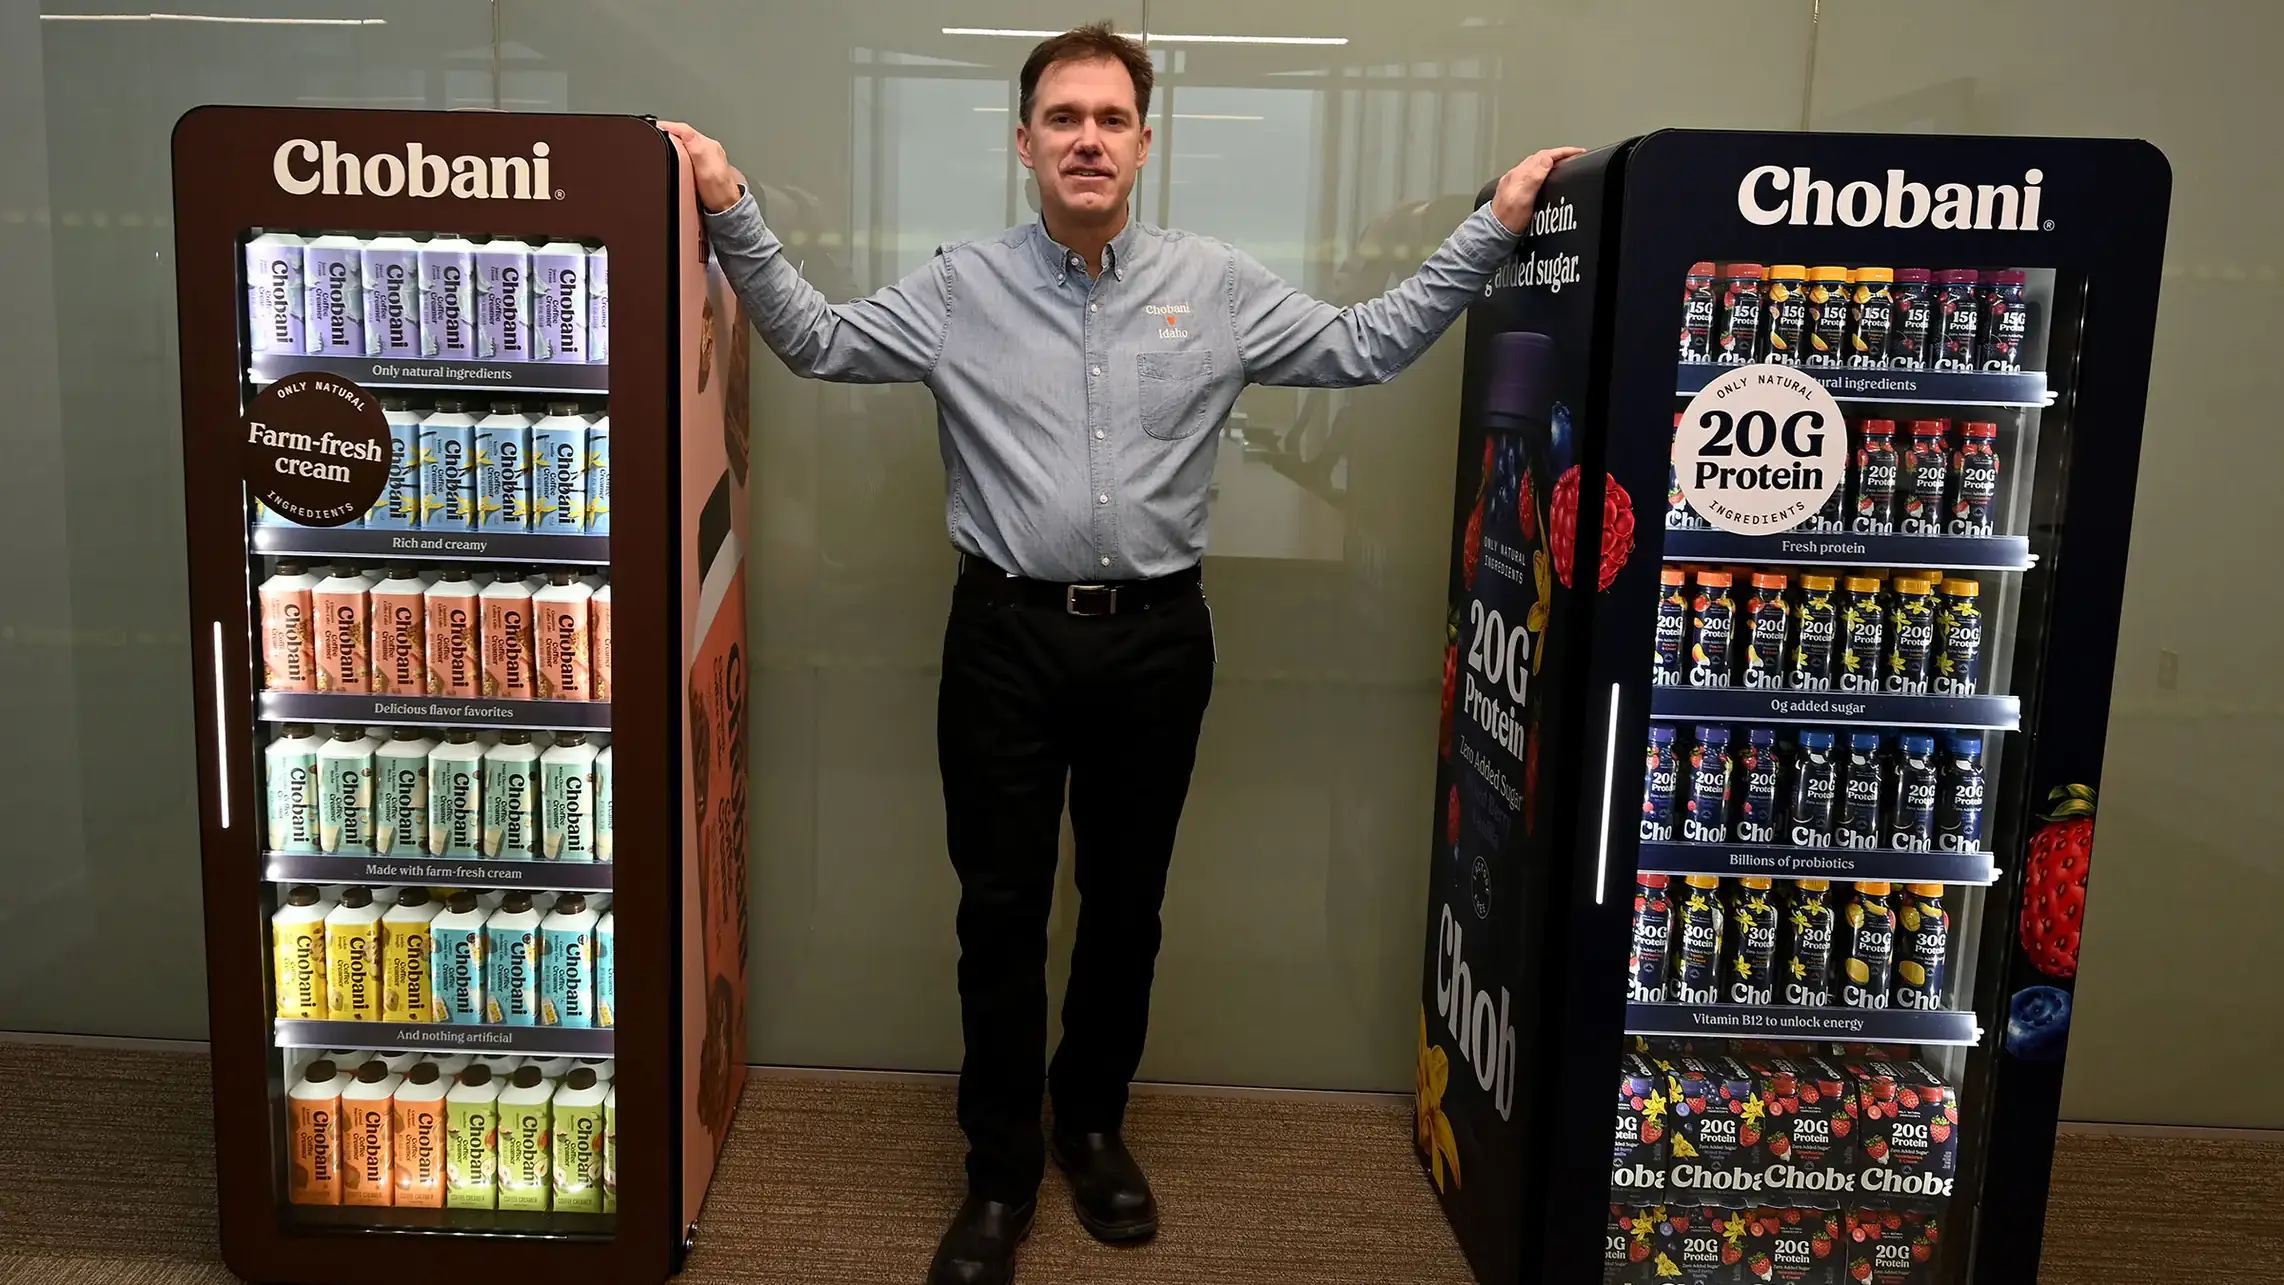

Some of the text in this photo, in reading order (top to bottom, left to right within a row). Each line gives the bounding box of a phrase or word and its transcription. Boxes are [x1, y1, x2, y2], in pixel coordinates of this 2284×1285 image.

[273, 139, 551, 200] Chobani
[1738, 165, 2043, 231] Chobani
[1529, 196, 1577, 236] rotein.
[1495, 251, 1535, 288] added
[1536, 252, 1580, 293] sugar.
[271, 260, 293, 343] Chobani
[329, 263, 349, 346] Chobani
[386, 264, 409, 348] Chobani
[443, 266, 465, 349] Chobani
[502, 267, 522, 351] Chobani
[559, 269, 578, 353] Chobani
[1145, 302, 1190, 316] Chobani
[1824, 306, 1847, 319] 15G
[1864, 307, 1890, 319] 15G
[1953, 311, 1977, 323] 15G
[2002, 312, 2026, 324] 15G
[1158, 328, 1188, 339] Idaho
[372, 365, 512, 380] Only natural ingredients
[1845, 378, 1917, 391] ingredients
[277, 381, 364, 412] ONLY NATURAL
[1716, 374, 1813, 401] ONLY NATURAL
[248, 421, 382, 462] Farm-fresh
[1698, 410, 1825, 458] 20G
[274, 457, 350, 483] cream
[444, 440, 463, 521] Chobani
[500, 442, 520, 523] Chobani
[1694, 460, 1823, 490] Protein
[1869, 465, 1896, 478] 20G
[1918, 467, 1945, 480] 20G
[1965, 468, 1995, 481] 20G
[557, 443, 576, 525] Chobani
[266, 490, 354, 519] INGREDIENTS
[1708, 500, 1806, 525] INGREDIENTS
[392, 537, 487, 552] Rich and creamy
[1484, 536, 1526, 566] ONLY NATURAL
[1782, 540, 1866, 555] Fresh protein
[1484, 555, 1524, 585] INGREDIENTS
[1804, 621, 1833, 634] 20G
[1855, 623, 1882, 636] 20G
[1902, 625, 1931, 638] 20G
[1950, 627, 1980, 641] 20G
[284, 604, 305, 681] Chobani
[337, 606, 359, 683] Chobani
[395, 607, 414, 685] Chobani
[450, 609, 469, 687] Chobani
[504, 611, 524, 689] Chobani
[558, 614, 578, 691] Chobani
[1467, 599, 1530, 707] 20G
[374, 702, 513, 718] Delicious flavor favorites
[1464, 671, 1525, 762] Protein
[1790, 701, 1829, 712] added
[1831, 703, 1866, 715] sugar
[1460, 735, 1474, 764] Zero
[1473, 751, 1500, 793] Added
[1501, 774, 1523, 811] Sugar
[1695, 772, 1723, 785] 20G
[1694, 783, 1723, 793] Protein
[1849, 780, 1878, 793] 20G
[1909, 785, 1936, 797] 20G
[1956, 785, 1983, 798] 20G
[291, 768, 310, 842] Chobani
[342, 771, 363, 845] Chobani
[398, 770, 416, 846] Chobani
[453, 772, 471, 848] Chobani
[508, 773, 525, 849] Chobani
[566, 776, 584, 851] Chobani
[365, 864, 522, 879] Made with farm-fresh cream
[1730, 854, 1855, 869] Billions of probiotics
[1634, 935, 1667, 947] Protein
[1683, 924, 1713, 939] 30G
[1860, 931, 1892, 945] 30G
[1916, 933, 1946, 947] 30G
[297, 935, 316, 1007] Chobani
[350, 937, 369, 1010] Chobani
[407, 934, 425, 1009] Chobani
[455, 941, 474, 1014] Chobani
[510, 942, 528, 1016] Chobani
[566, 943, 582, 1017] Chobani
[1693, 1013, 1864, 1031] Vitamin B12 to unlock energy
[396, 1030, 512, 1044] And nothing artificial
[1700, 1119, 1736, 1134] 20G
[1700, 1133, 1736, 1143] Protein
[1793, 1118, 1828, 1134] 20G
[1793, 1133, 1829, 1144] Protein
[1892, 1122, 1928, 1139] 20G
[313, 1111, 331, 1181] Chobani
[365, 1111, 382, 1182] Chobani
[577, 1117, 593, 1189] Chobani
[1892, 1137, 1928, 1148] Protein
[1683, 1253, 1718, 1261] Protein
[1684, 1238, 1719, 1253] 20G
[1775, 1239, 1810, 1254] 20G
[1876, 1244, 1910, 1259] 20G
[1774, 1254, 1810, 1264] Protein
[1875, 1258, 1910, 1268] Protein
